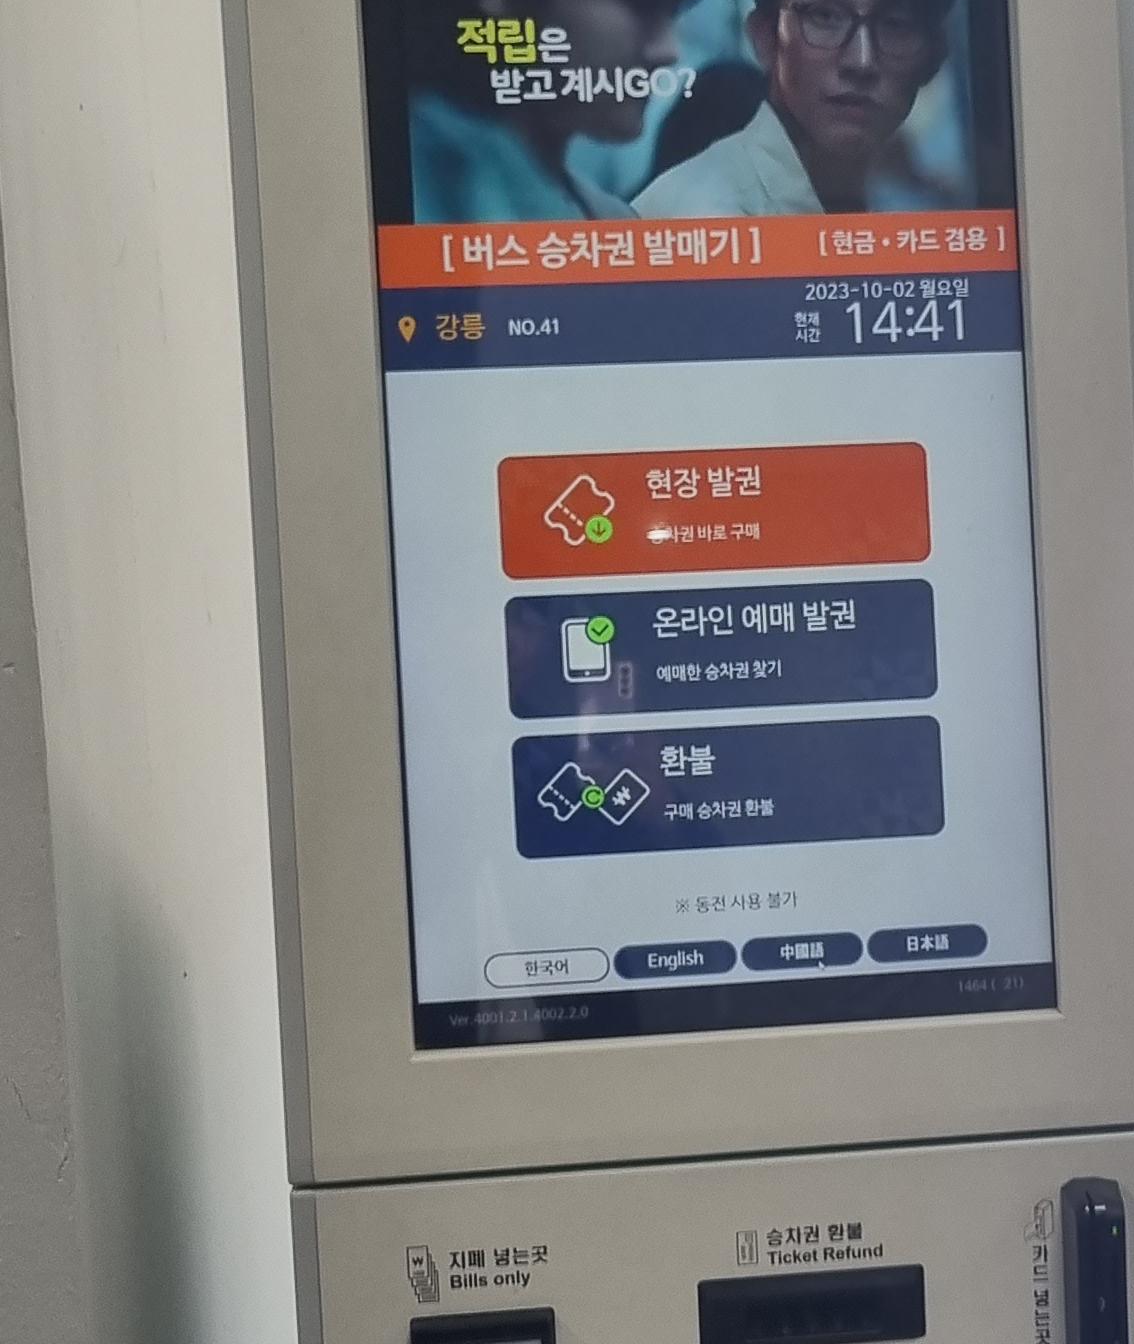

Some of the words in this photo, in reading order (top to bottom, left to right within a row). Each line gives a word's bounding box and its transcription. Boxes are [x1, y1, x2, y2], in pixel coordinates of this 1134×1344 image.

[456, 17, 572, 64] 적립은
[490, 67, 558, 104] 받고
[560, 65, 697, 103] 계시GO?
[462, 233, 530, 270] 버스
[536, 230, 636, 268] 승차권
[643, 225, 743, 265] 발매기
[832, 230, 876, 255] 현금
[896, 228, 940, 254] 카드
[945, 227, 988, 252] 겸용
[805, 281, 915, 301] 2023-10-02
[919, 278, 969, 299] 월요일
[435, 314, 485, 341] 강릉
[508, 317, 560, 338] NO.41
[846, 299, 966, 345] 14:41
[795, 328, 822, 343] 시간
[645, 468, 699, 499] 현장
[707, 465, 762, 497] 발권
[646, 524, 694, 544] 차권
[697, 524, 728, 542] 바로
[730, 523, 760, 540] 구매
[653, 606, 734, 638] 온라인
[742, 603, 794, 634] 예매
[803, 599, 857, 631] 발권
[656, 663, 702, 682] 예매한
[705, 662, 750, 680] 승차권
[752, 659, 782, 678] 찾기
[660, 745, 716, 777] 환불
[664, 803, 694, 821] 구매
[697, 800, 742, 820] 승차권
[745, 798, 775, 818] 환불
[697, 895, 725, 913] 동전
[731, 892, 760, 910] 사용
[768, 891, 797, 909] 불가
[906, 934, 950, 953] 日本語
[524, 958, 570, 977] 한국어
[647, 950, 705, 972] English
[766, 1224, 820, 1246] 승차권
[449, 1250, 485, 1269] 지폐
[493, 1244, 549, 1267] 넣는곳
[767, 1249, 818, 1265] Ticket
[823, 1243, 884, 1261] Refund
[1032, 1244, 1050, 1282] 카드
[450, 1272, 488, 1289] Bills
[493, 1269, 531, 1288] only
